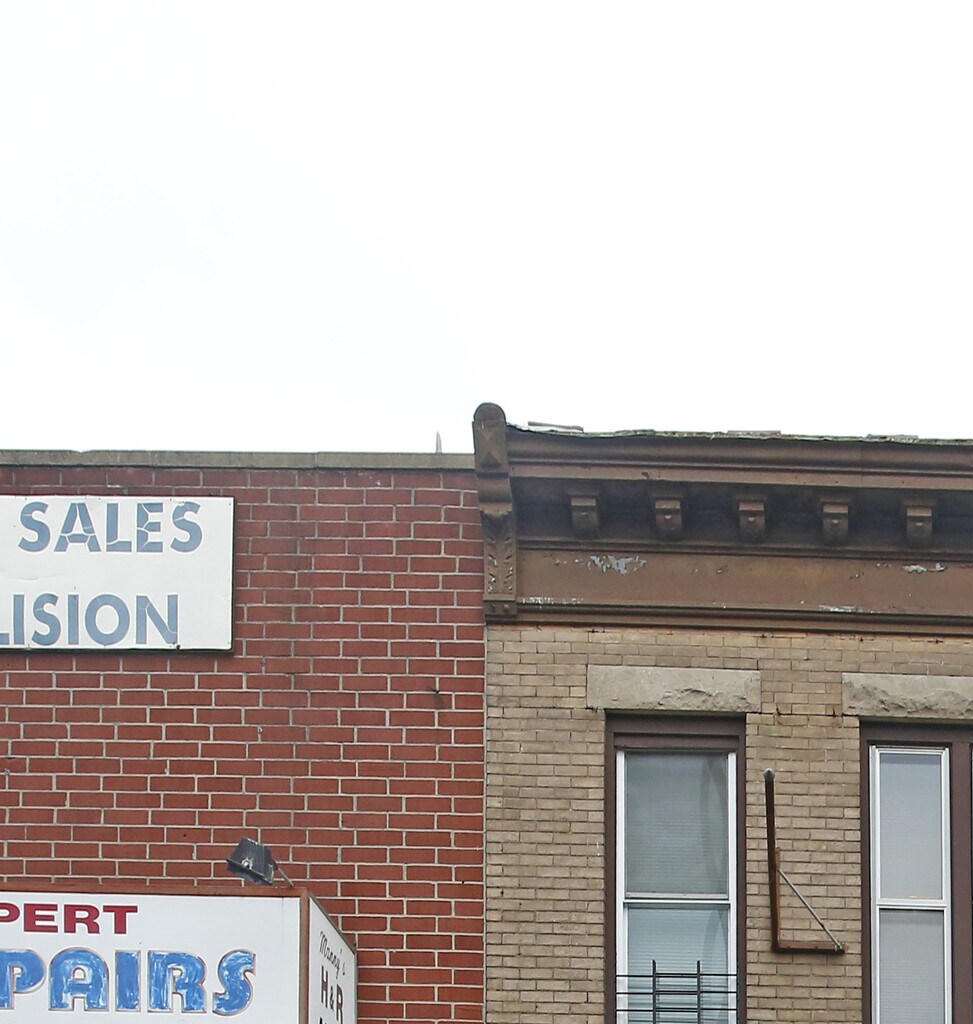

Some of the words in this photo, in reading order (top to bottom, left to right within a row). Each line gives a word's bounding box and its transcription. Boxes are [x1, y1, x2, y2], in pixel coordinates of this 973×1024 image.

[18, 501, 203, 553] SALES
[0, 946, 256, 1017] PAIRS
[320, 964, 329, 1009] H
[329, 985, 335, 1012] &
